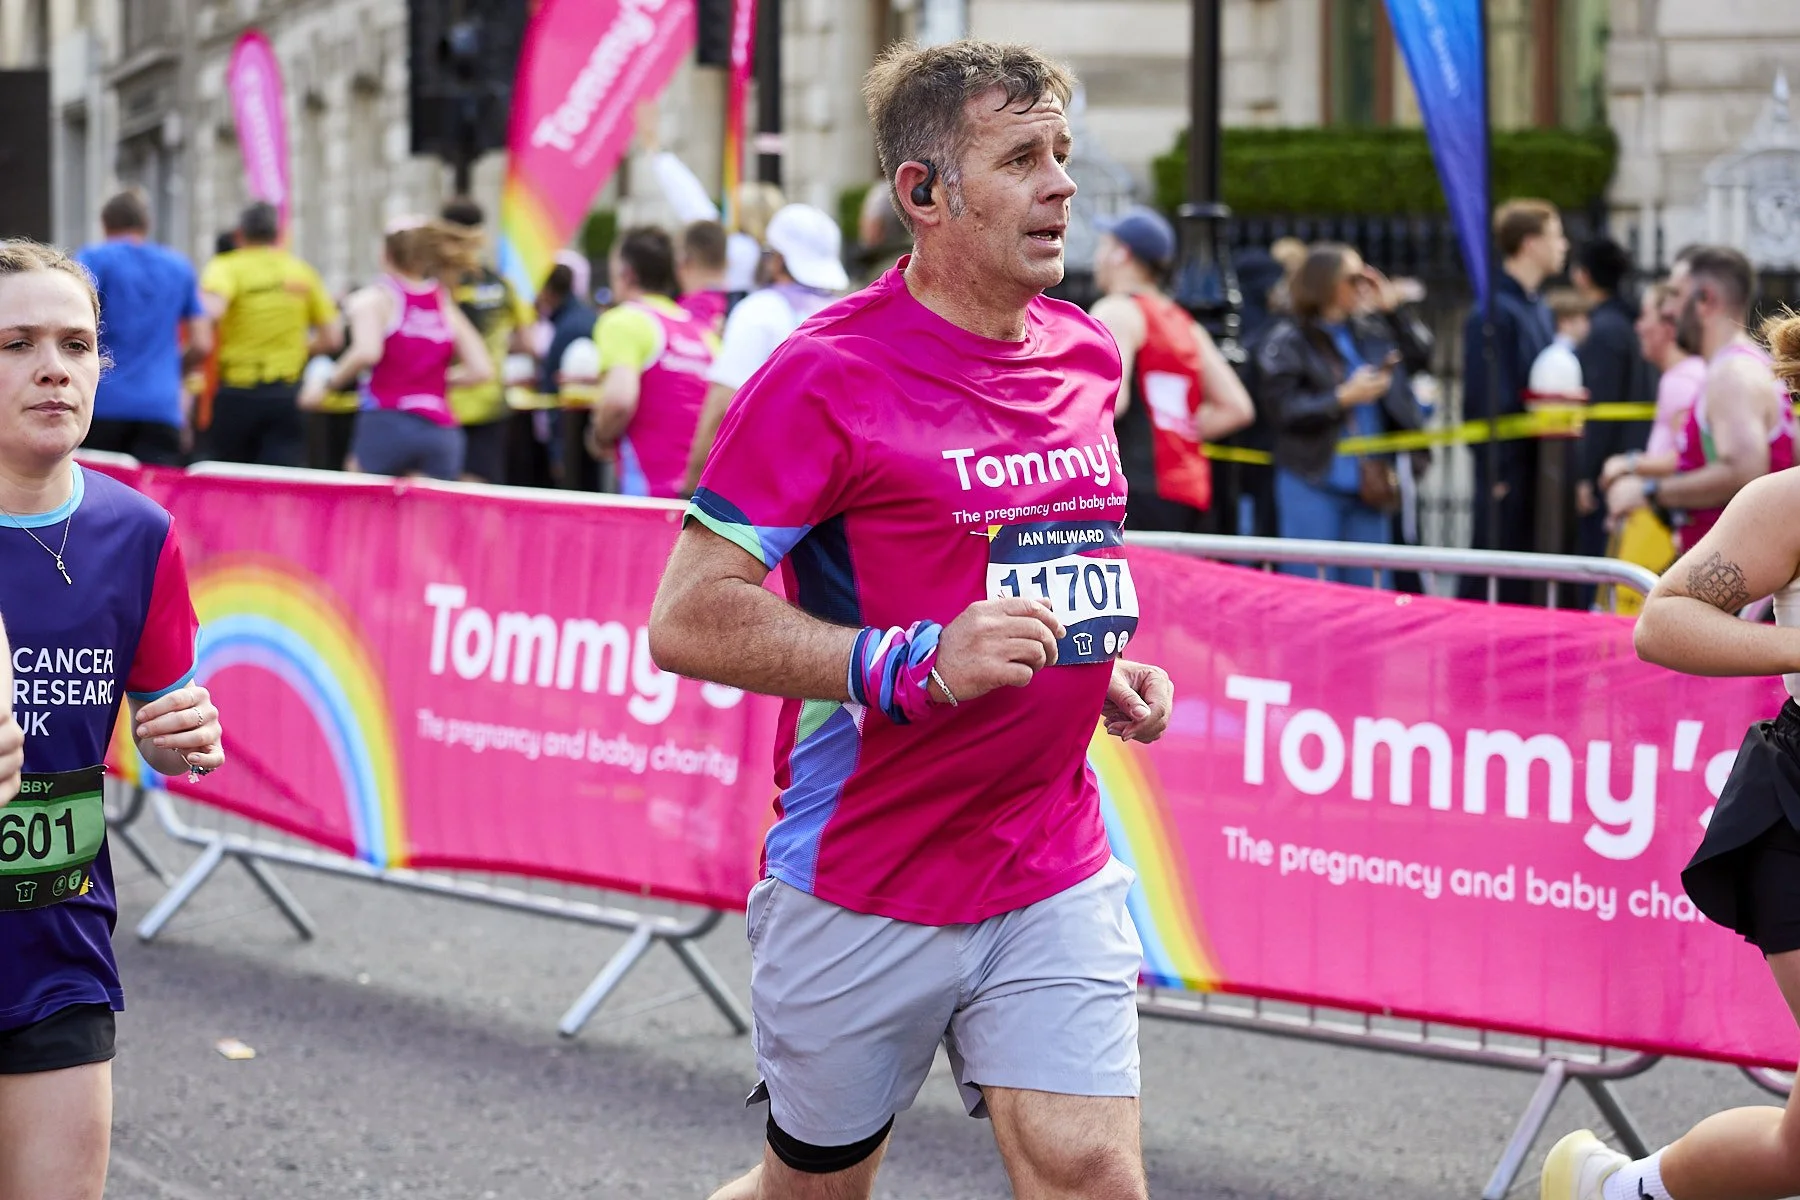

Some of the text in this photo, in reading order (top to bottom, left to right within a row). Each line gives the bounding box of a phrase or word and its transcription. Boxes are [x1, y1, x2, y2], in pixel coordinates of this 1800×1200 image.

[952, 510, 981, 525] The
[985, 504, 1050, 523] pregnancy
[1053, 496, 1077, 513] and
[1079, 494, 1105, 510] baby
[1017, 529, 1105, 547] IAN MILWARD
[1000, 563, 1122, 613] 11707
[12, 647, 114, 674] CANCER
[424, 582, 745, 726] Tommy
[12, 679, 115, 705] RESEARC
[12, 711, 51, 737] UK
[416, 708, 739, 786] The pregnancy and baby charity
[19, 780, 54, 794] BBY
[1221, 826, 1274, 867] The
[1279, 843, 1443, 900] pregnancy
[1449, 863, 1516, 902] and
[1526, 866, 1618, 921] baby
